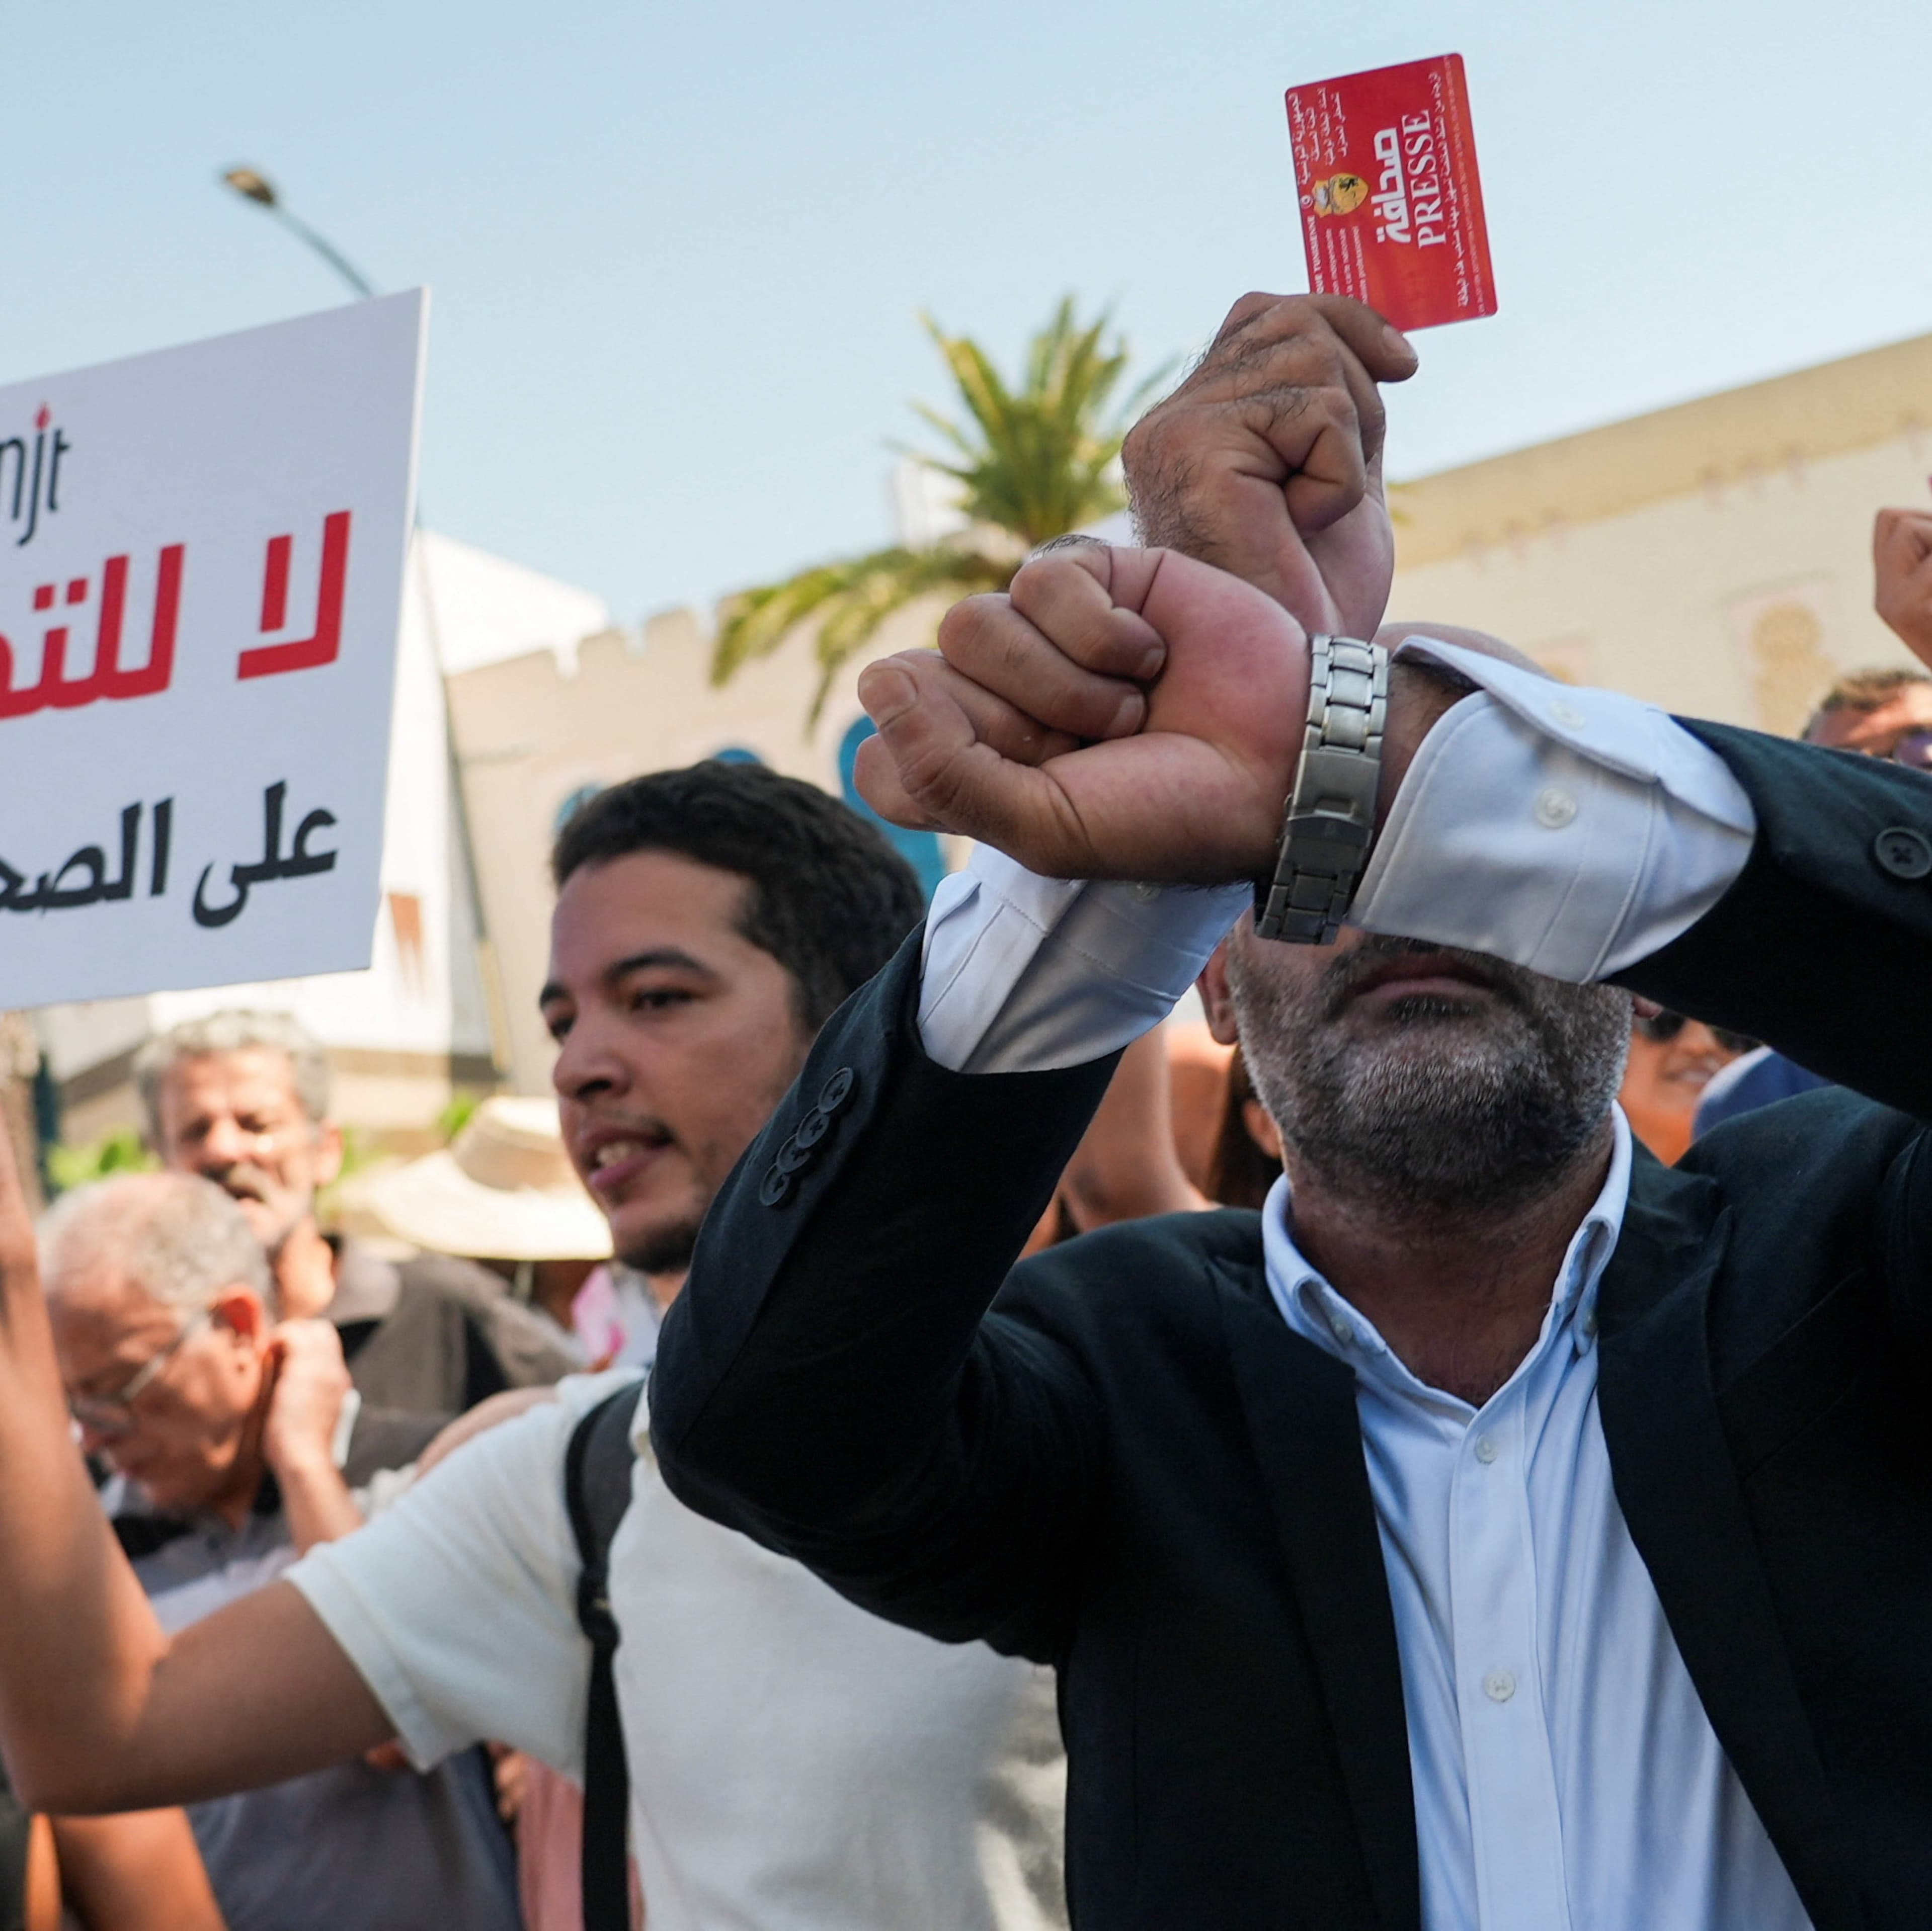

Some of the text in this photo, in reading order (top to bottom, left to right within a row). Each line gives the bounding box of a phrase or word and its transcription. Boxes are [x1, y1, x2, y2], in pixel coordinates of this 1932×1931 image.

[1288, 93, 1311, 186] الجمهورية التونسية
[1371, 127, 1411, 243] صحافة
[1401, 110, 1446, 248] PRESSE
[1307, 215, 1324, 295] QUE TUNISIENNE
[0, 402, 70, 546] njt
[0, 510, 352, 718] لا للت
[0, 779, 338, 928] على الصح
